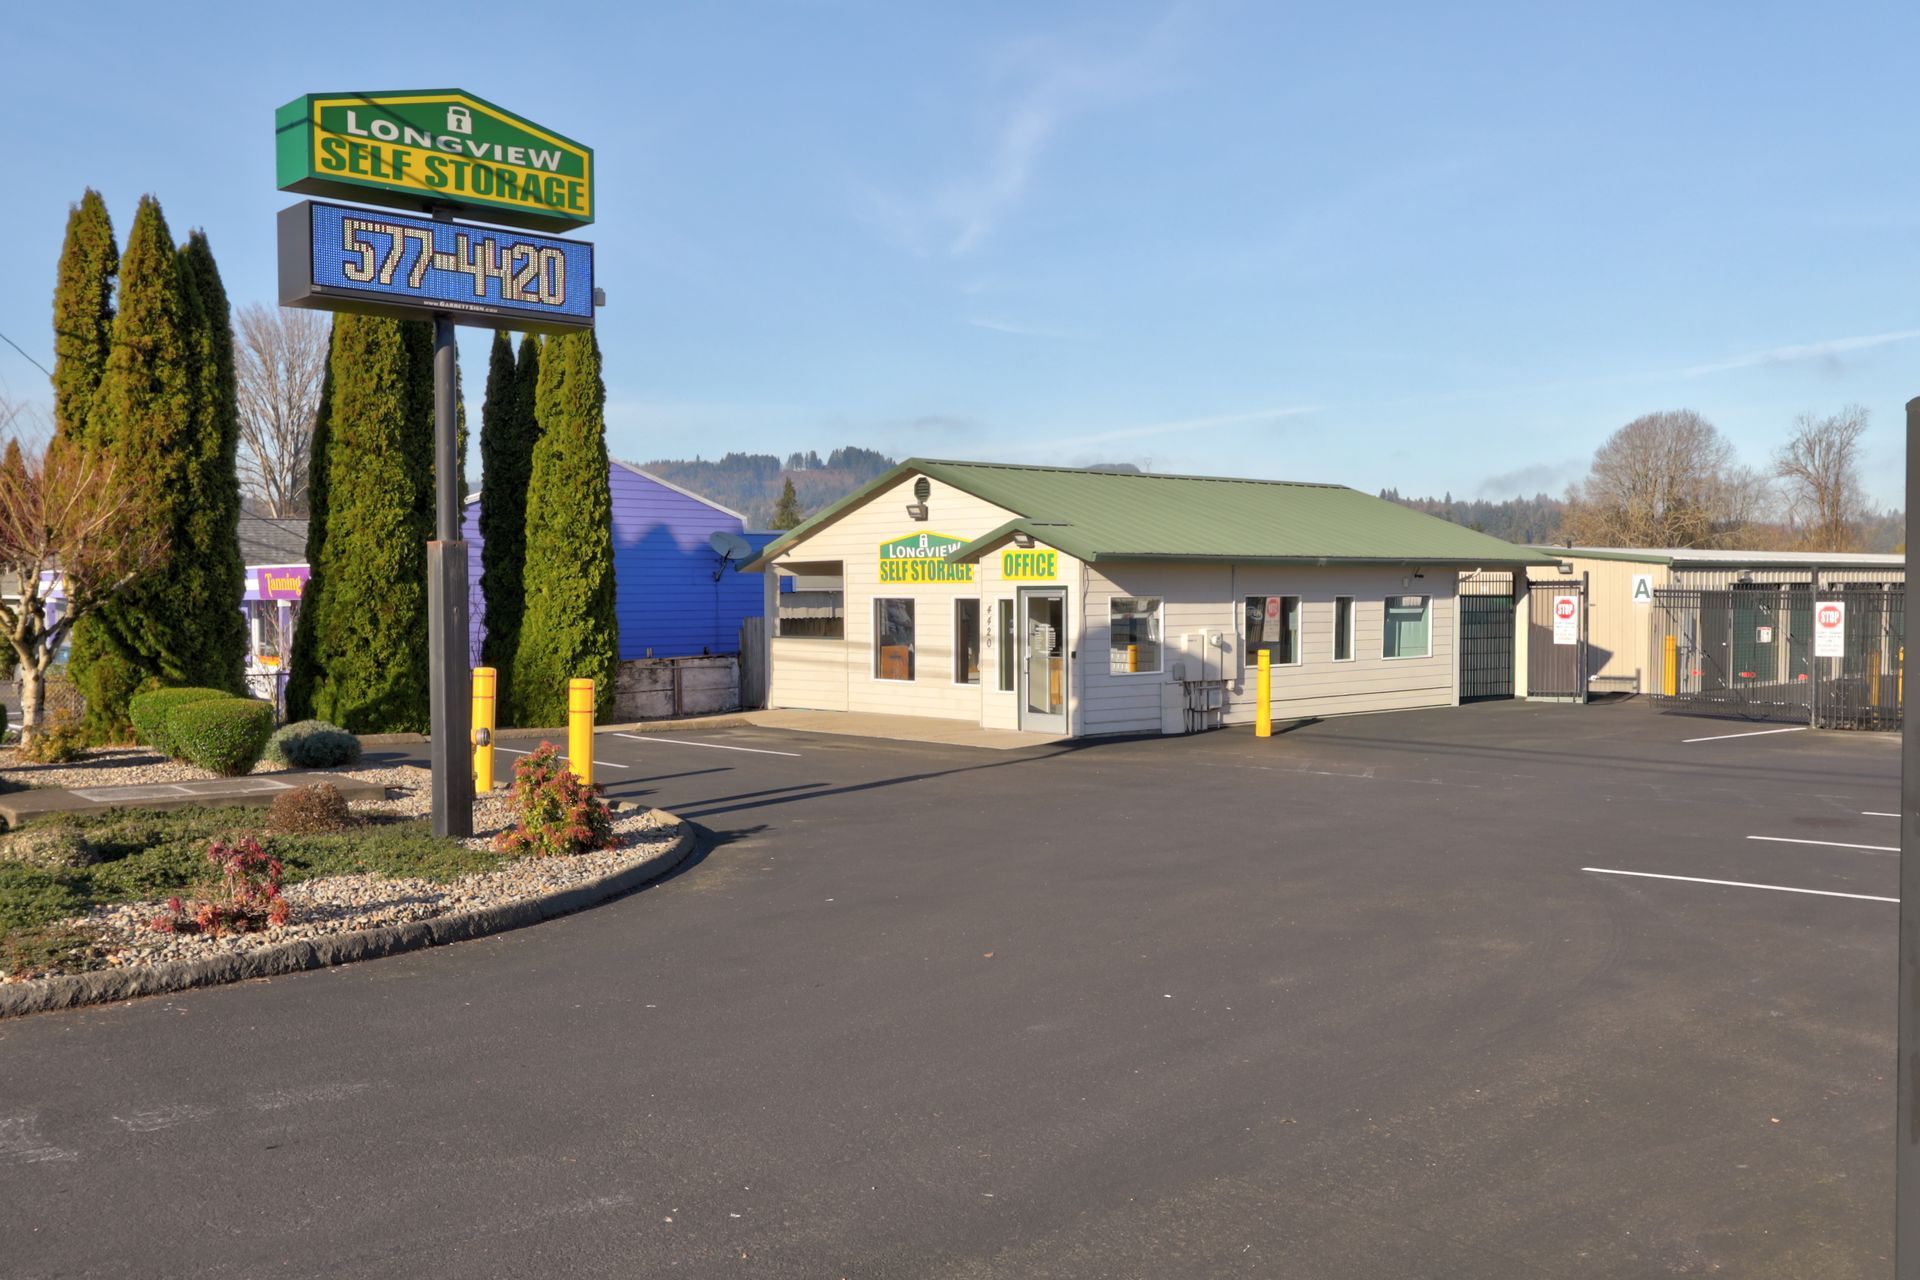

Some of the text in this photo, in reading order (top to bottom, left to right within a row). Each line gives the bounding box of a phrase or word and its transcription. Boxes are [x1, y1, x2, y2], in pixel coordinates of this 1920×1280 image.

[347, 110, 562, 171] LONGVIEW
[320, 137, 585, 211] SELF STORAGE
[343, 216, 565, 306] 577-4420
[880, 560, 973, 581] SELF STORAGE
[1004, 553, 1055, 577] OFFICE
[264, 572, 301, 597] Tanning
[1634, 578, 1651, 598] A
[1557, 603, 1574, 615] STOP
[1820, 610, 1840, 624] STOP
